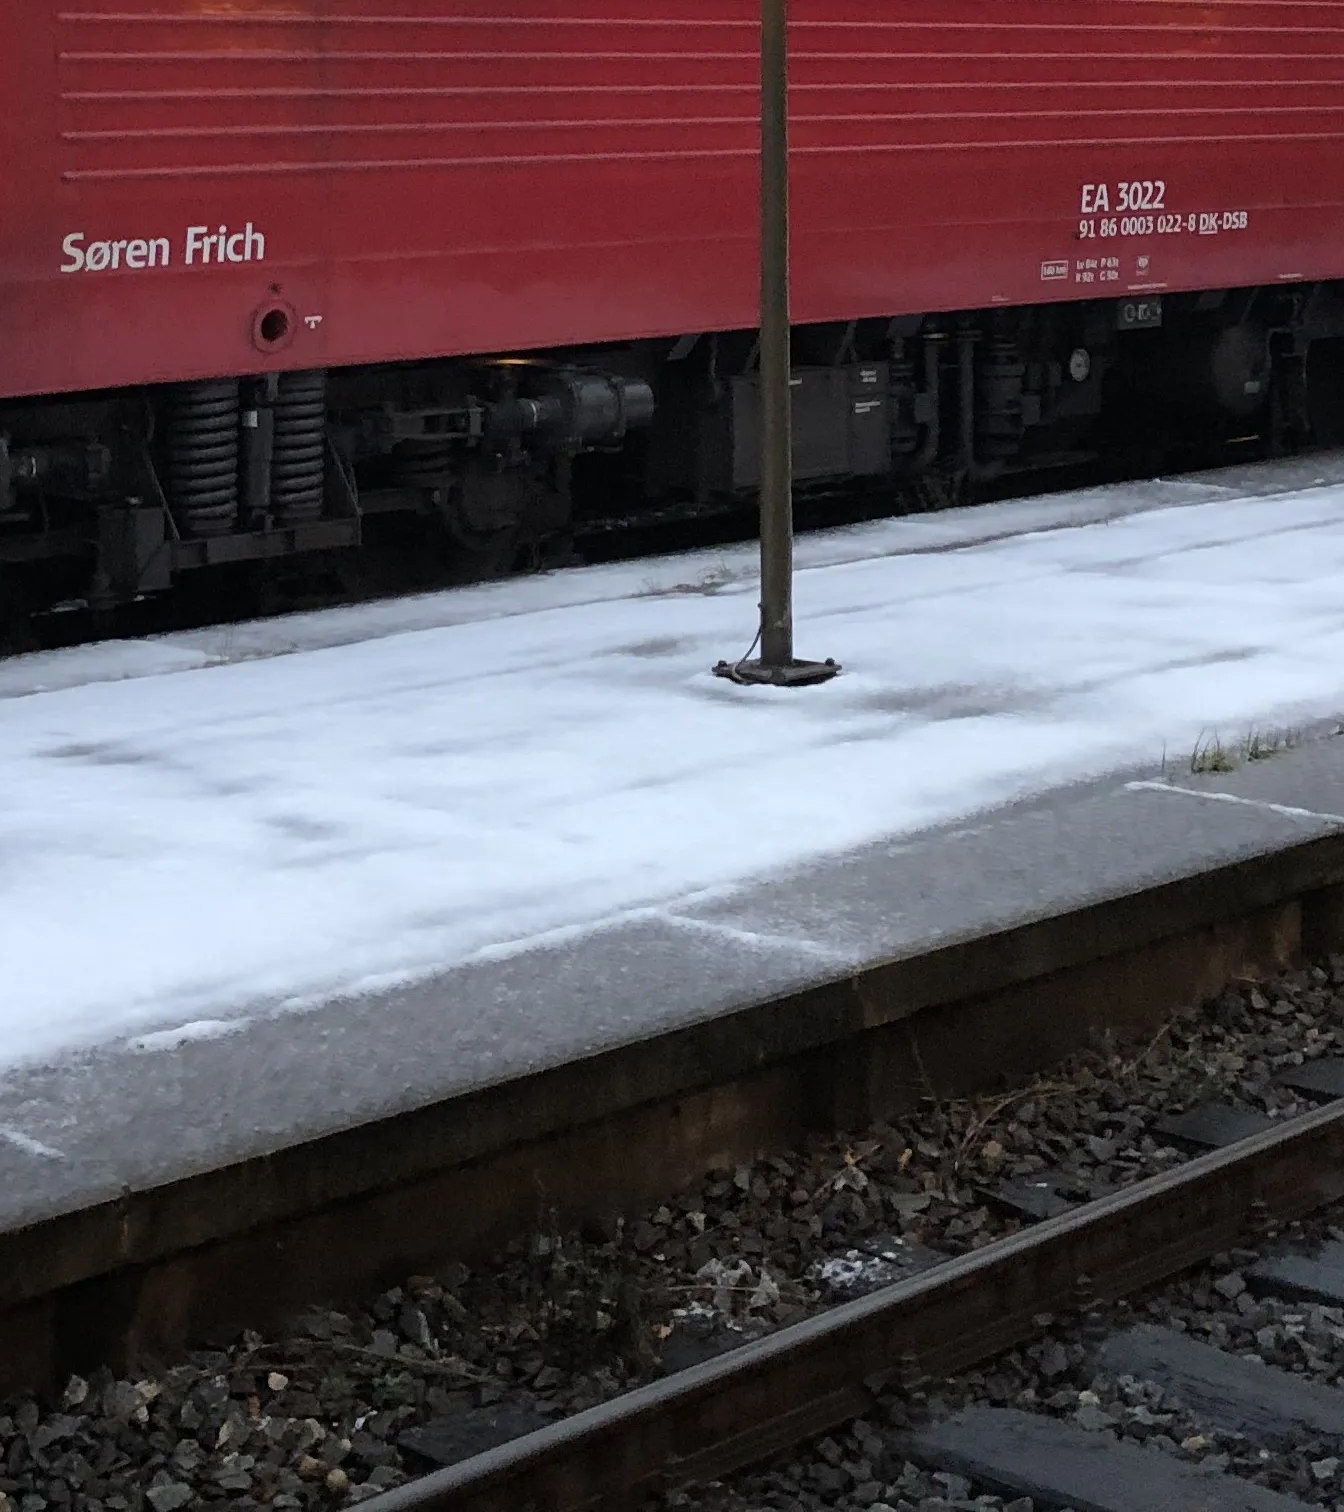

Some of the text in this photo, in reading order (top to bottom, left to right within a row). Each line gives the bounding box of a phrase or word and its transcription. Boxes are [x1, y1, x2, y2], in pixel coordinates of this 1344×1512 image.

[1081, 180, 1166, 213] EA 3022
[1079, 211, 1248, 239] 91 86 0003 022-8 DK-DSB
[60, 222, 264, 273] Søren Frich
